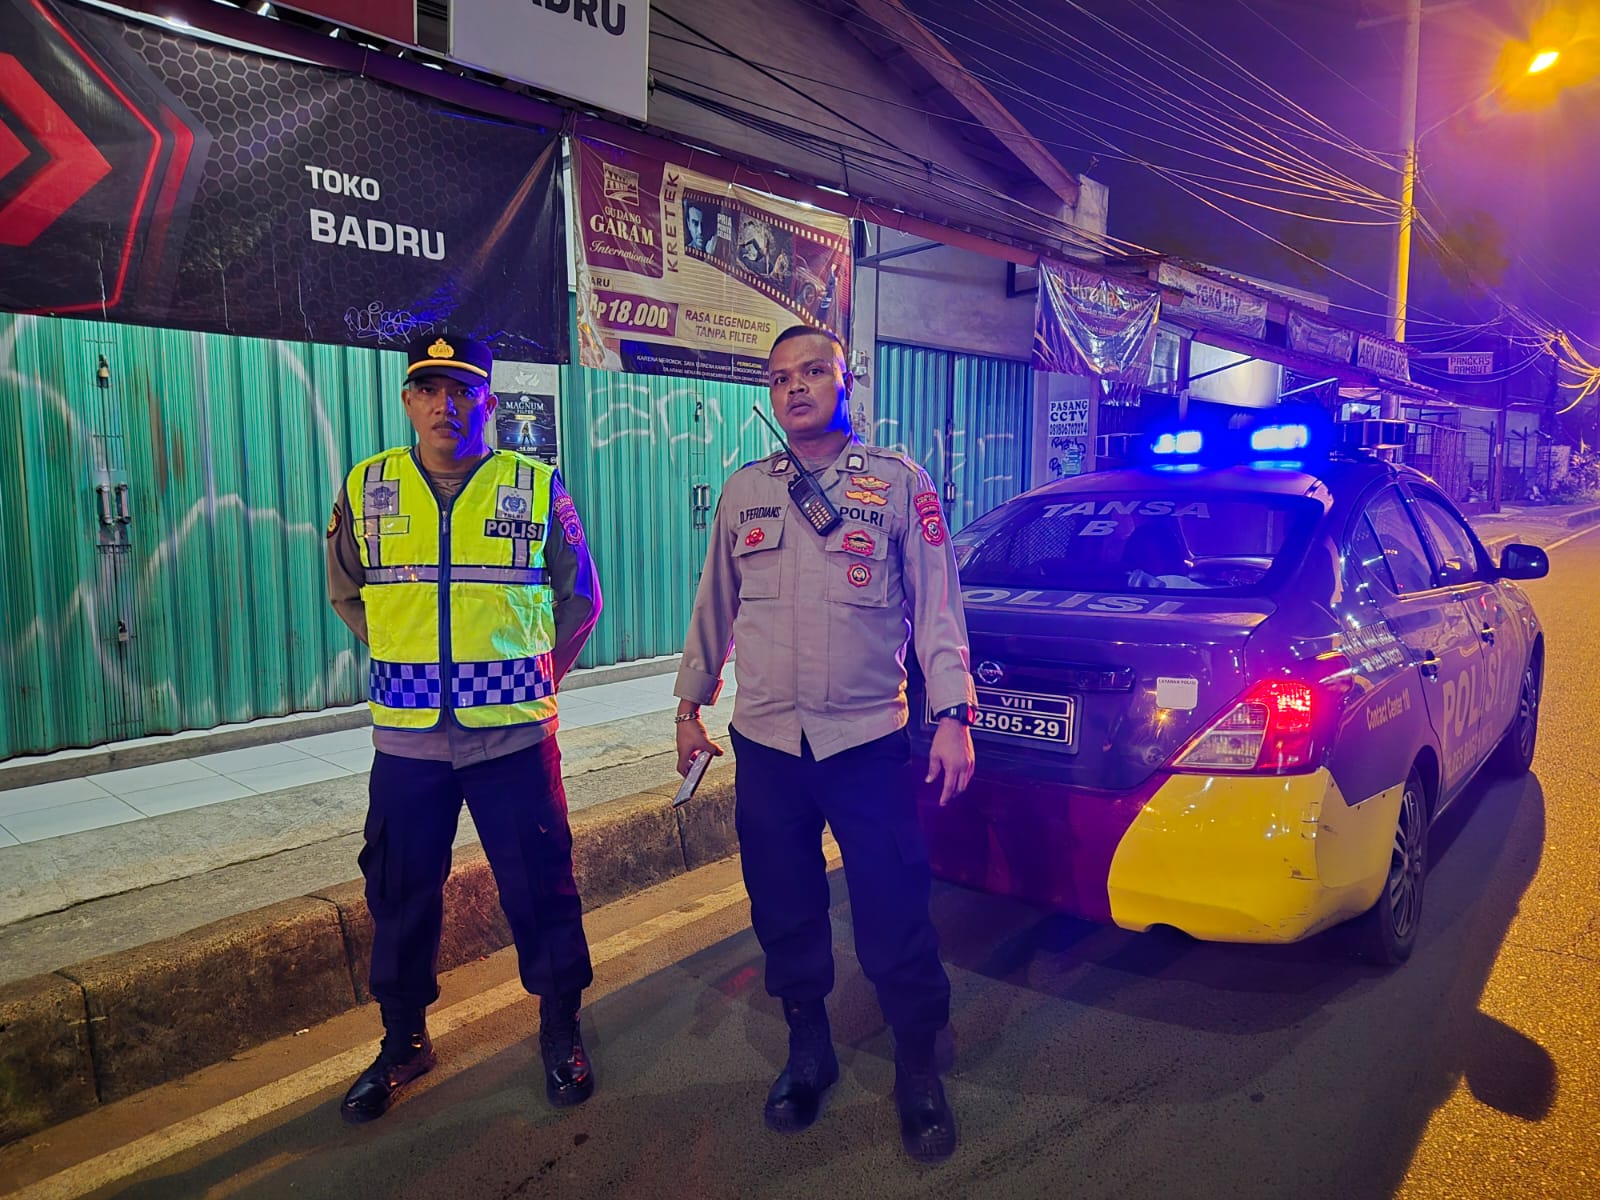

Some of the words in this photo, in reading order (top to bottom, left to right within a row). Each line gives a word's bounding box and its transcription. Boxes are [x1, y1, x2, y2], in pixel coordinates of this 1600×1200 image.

[304, 165, 381, 201] TOKO
[604, 206, 642, 225] GUDANG
[663, 173, 680, 273] KRETEK
[309, 208, 446, 261] BADRU
[589, 213, 655, 247] GARAM
[590, 239, 655, 265] International
[591, 278, 611, 288] ARU
[685, 309, 711, 323] RASA
[713, 312, 772, 333] LEGENDARIS
[696, 325, 727, 341] TANPA
[730, 330, 759, 345] FILTER
[505, 401, 544, 411] MAGNUM
[1050, 401, 1088, 411] PASANG
[1050, 410, 1088, 421] CCTV
[840, 506, 884, 527] POLRI
[1042, 500, 1211, 519] TANSA
[486, 521, 544, 539] POLISI
[1078, 520, 1119, 536] B
[961, 589, 1185, 616] OLISI
[1000, 696, 1033, 710] VIII
[1366, 704, 1388, 731] Contact
[1387, 695, 1403, 719] Center
